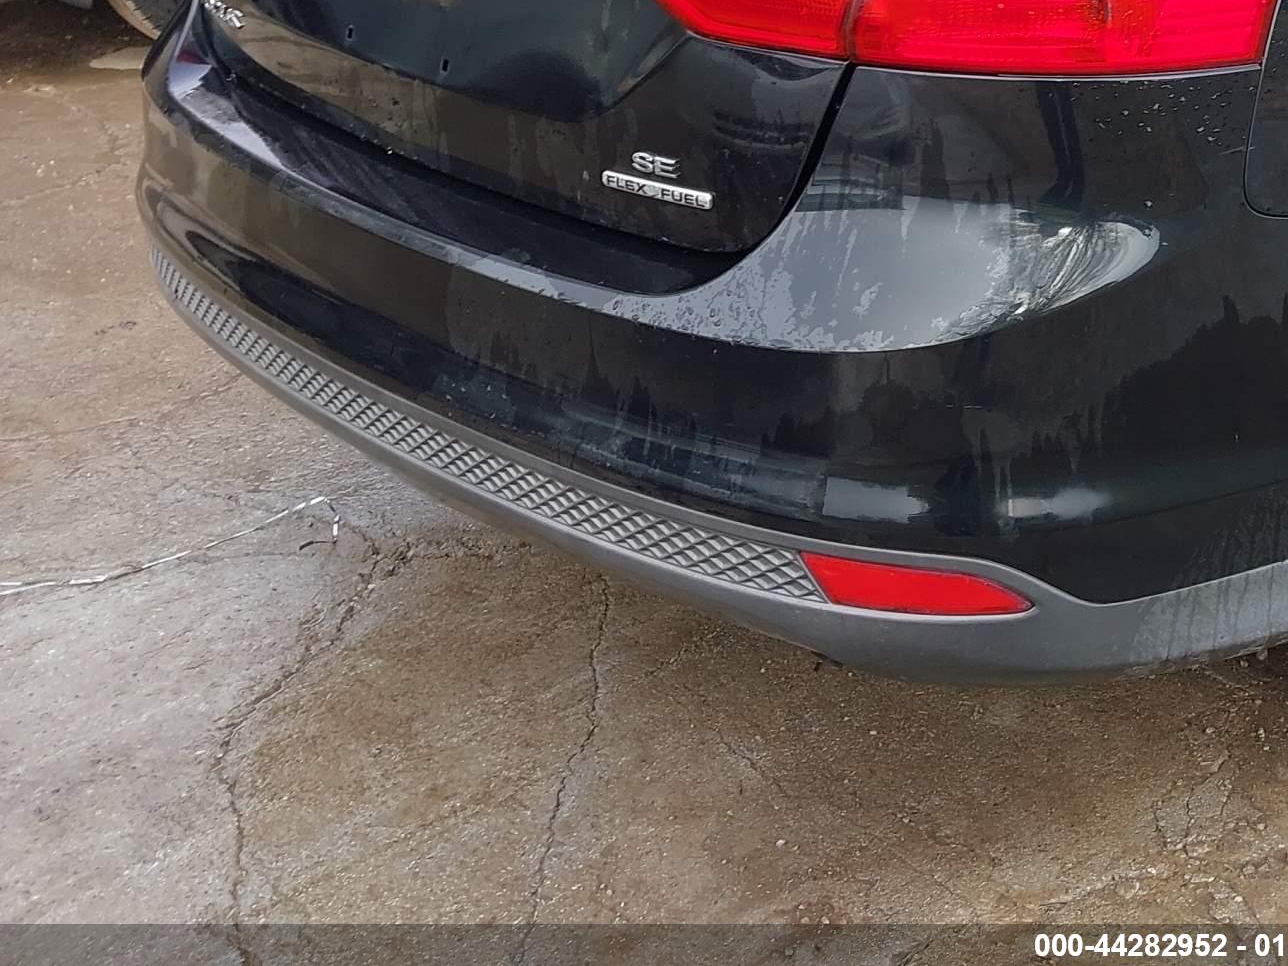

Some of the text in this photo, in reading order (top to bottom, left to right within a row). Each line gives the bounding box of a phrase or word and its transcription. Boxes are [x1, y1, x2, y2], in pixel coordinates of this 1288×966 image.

[631, 152, 680, 179] SE
[606, 174, 707, 208] FLEX FUEL
